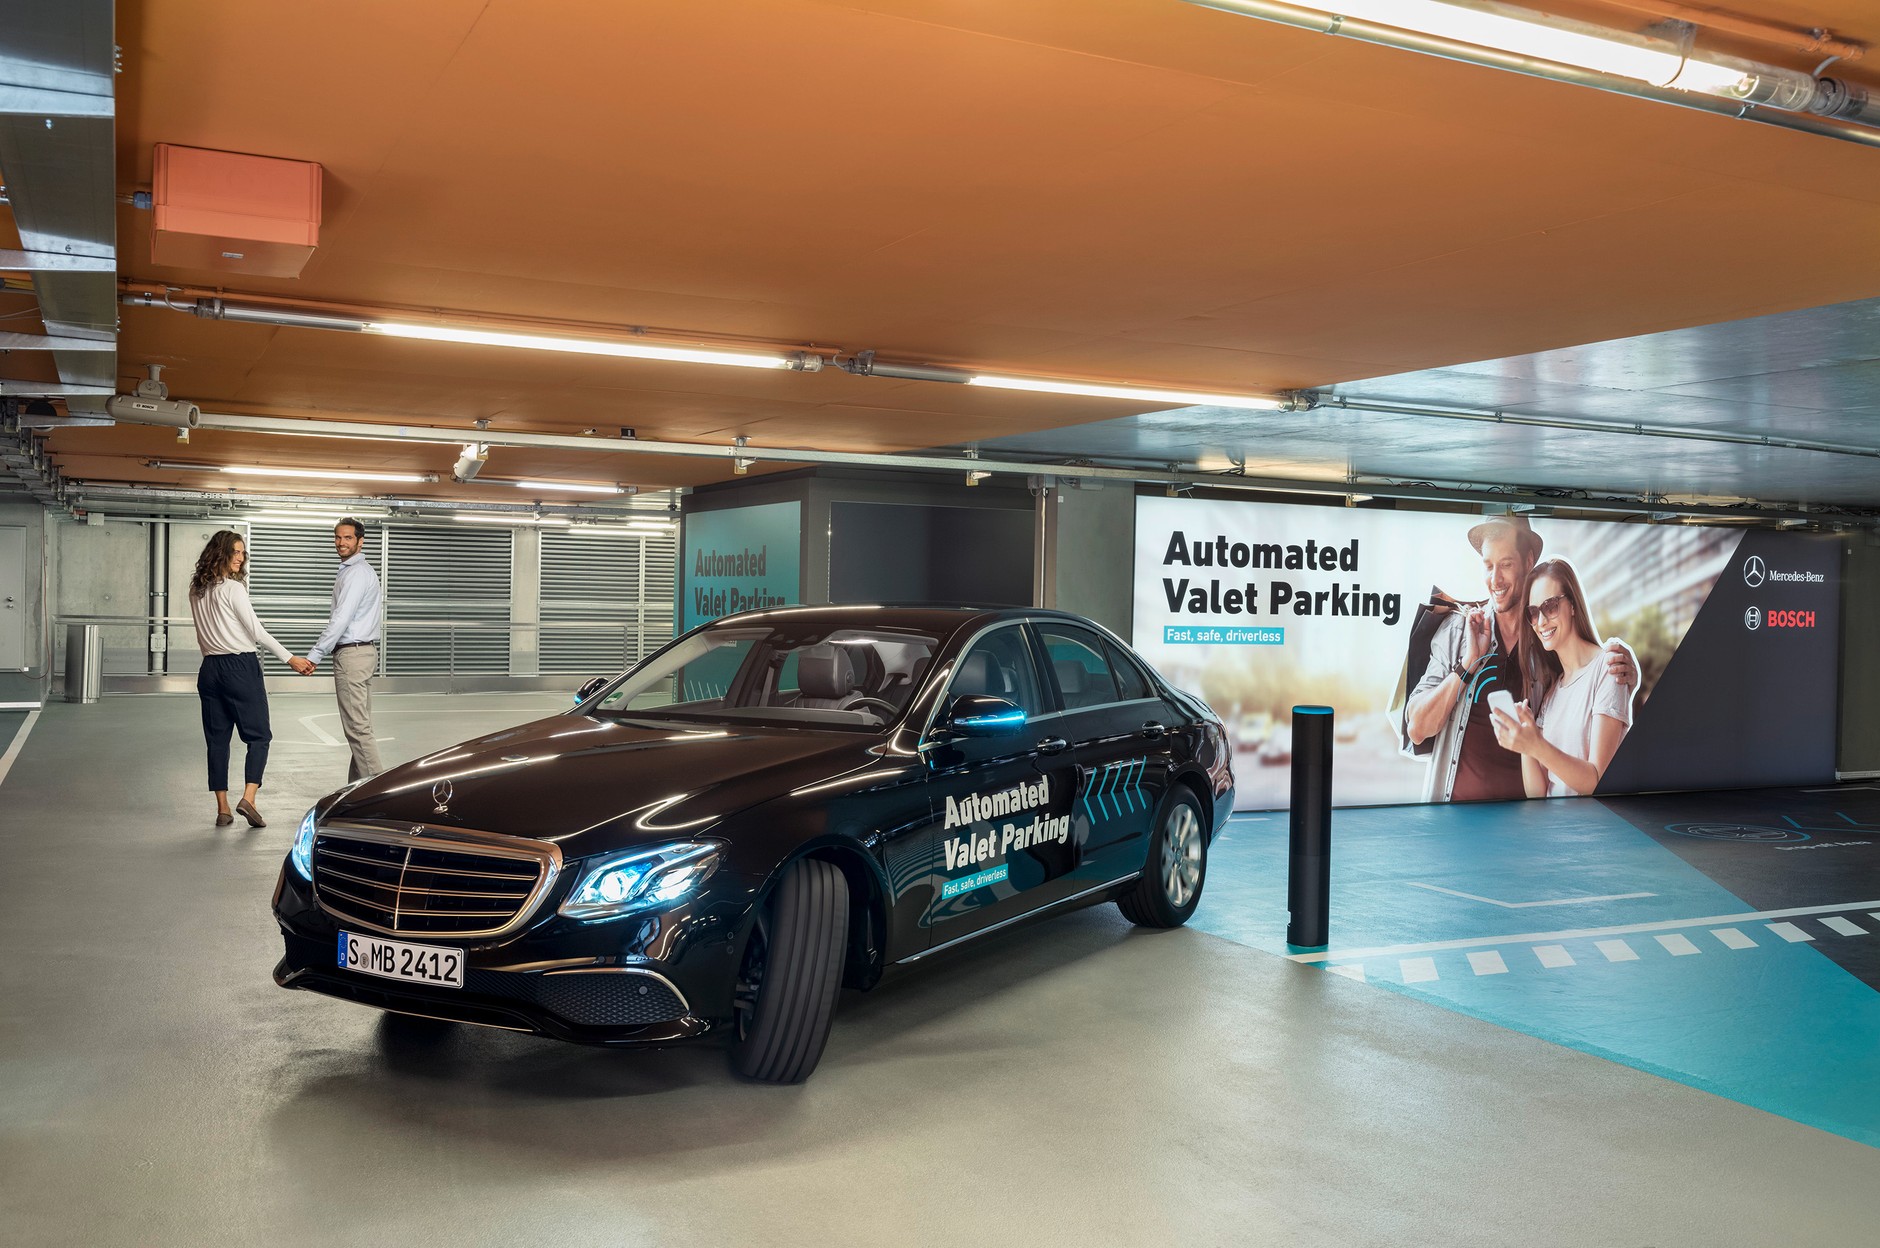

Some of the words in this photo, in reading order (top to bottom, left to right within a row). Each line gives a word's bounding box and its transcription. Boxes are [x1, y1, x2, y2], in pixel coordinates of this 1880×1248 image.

[694, 544, 767, 577] Automated
[1163, 530, 1359, 572] Automated
[1769, 569, 1825, 583] Mercedes-Benz
[694, 587, 727, 617] Valet
[1162, 577, 1258, 615] Valet
[1269, 580, 1401, 626] Parking
[1767, 609, 1816, 628] BOSCH
[1166, 628, 1195, 643] Fast,
[1196, 628, 1224, 643] safe,
[1225, 628, 1281, 643] driverless
[944, 775, 1049, 829] Automated
[944, 830, 996, 871] Valet
[1001, 813, 1070, 854] Parking
[943, 882, 960, 897] Fast,
[960, 877, 976, 892] safe,
[976, 869, 1007, 886] driverless
[349, 939, 358, 965] S
[371, 942, 395, 973] MB
[401, 949, 457, 982] 2412
